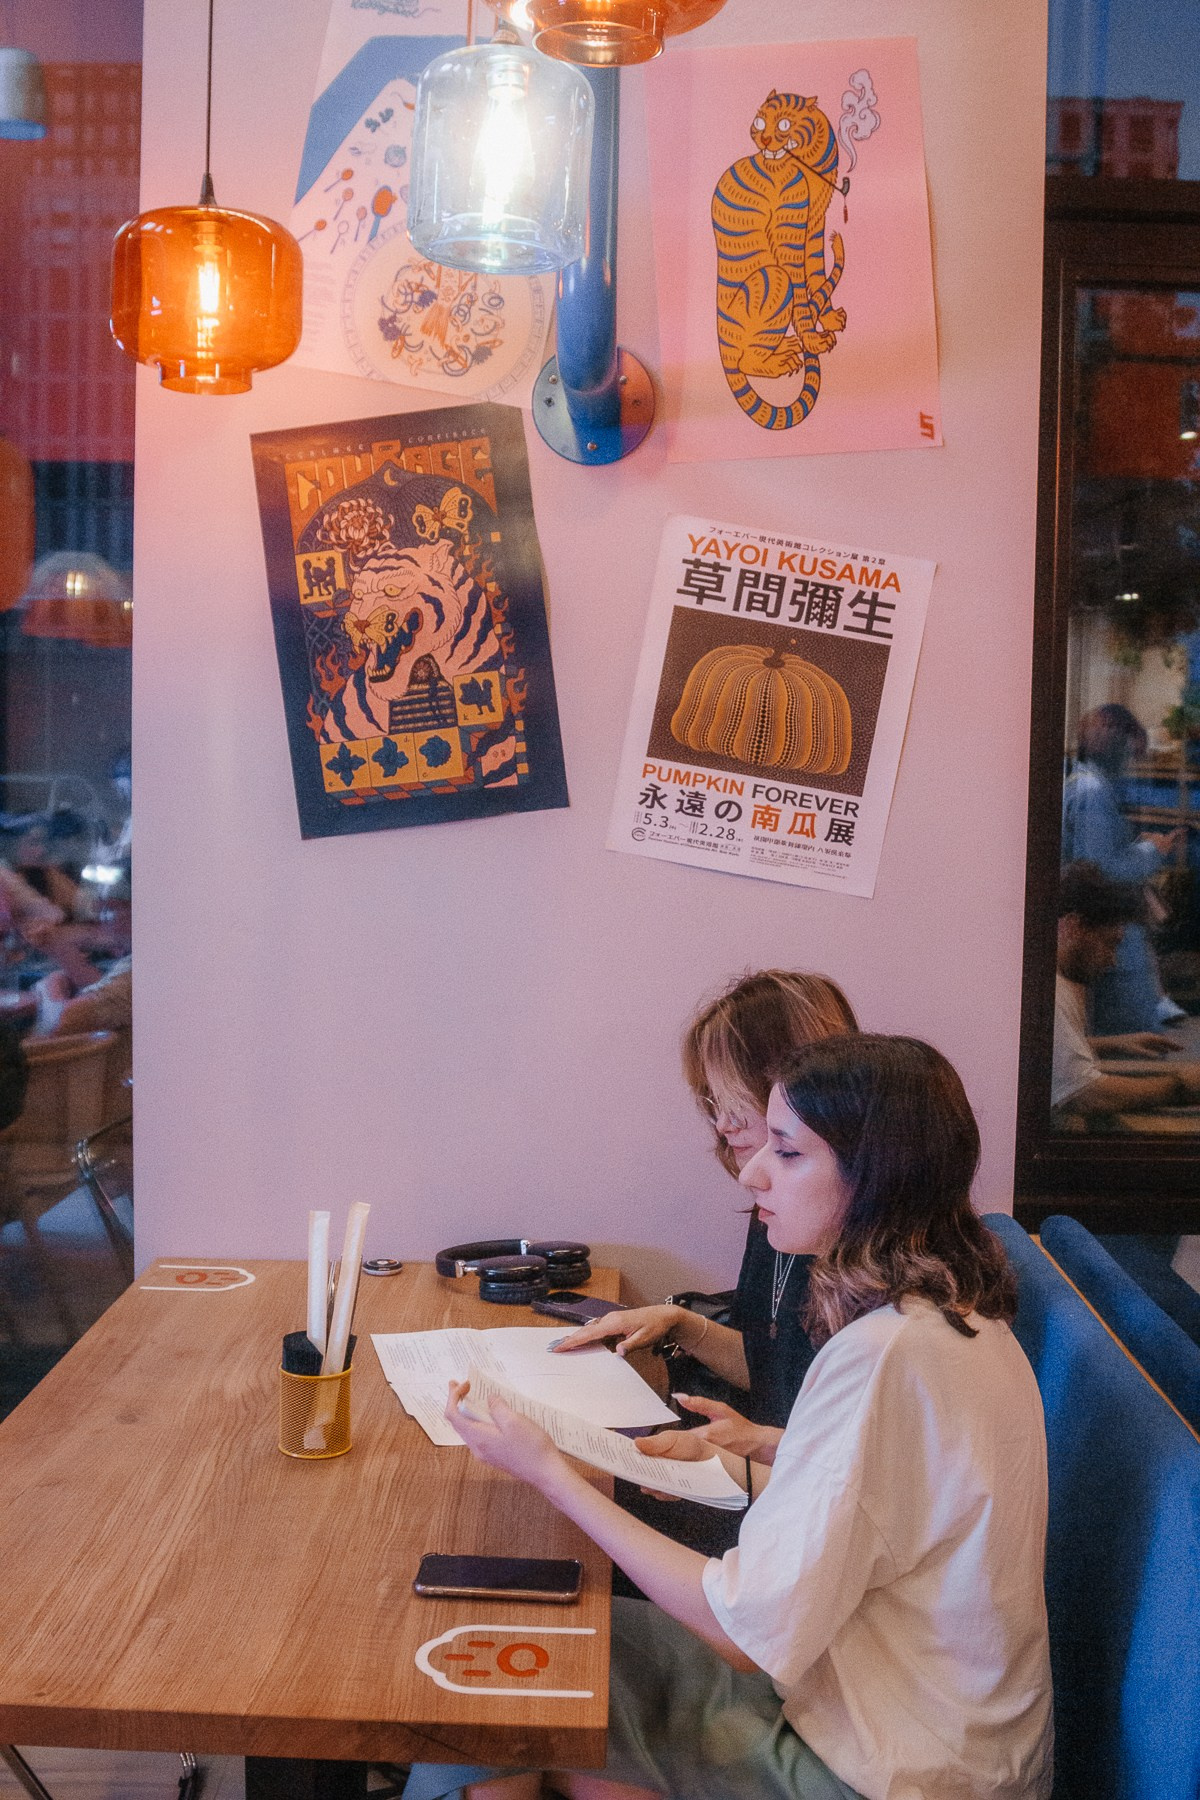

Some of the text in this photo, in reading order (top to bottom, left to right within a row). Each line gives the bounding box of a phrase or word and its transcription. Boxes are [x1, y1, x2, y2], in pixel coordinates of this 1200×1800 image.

[687, 533, 902, 593] YAYOI KUSAMA
[676, 558, 897, 640] 草間彌生
[641, 763, 860, 818] PUMPKIN FOREVER
